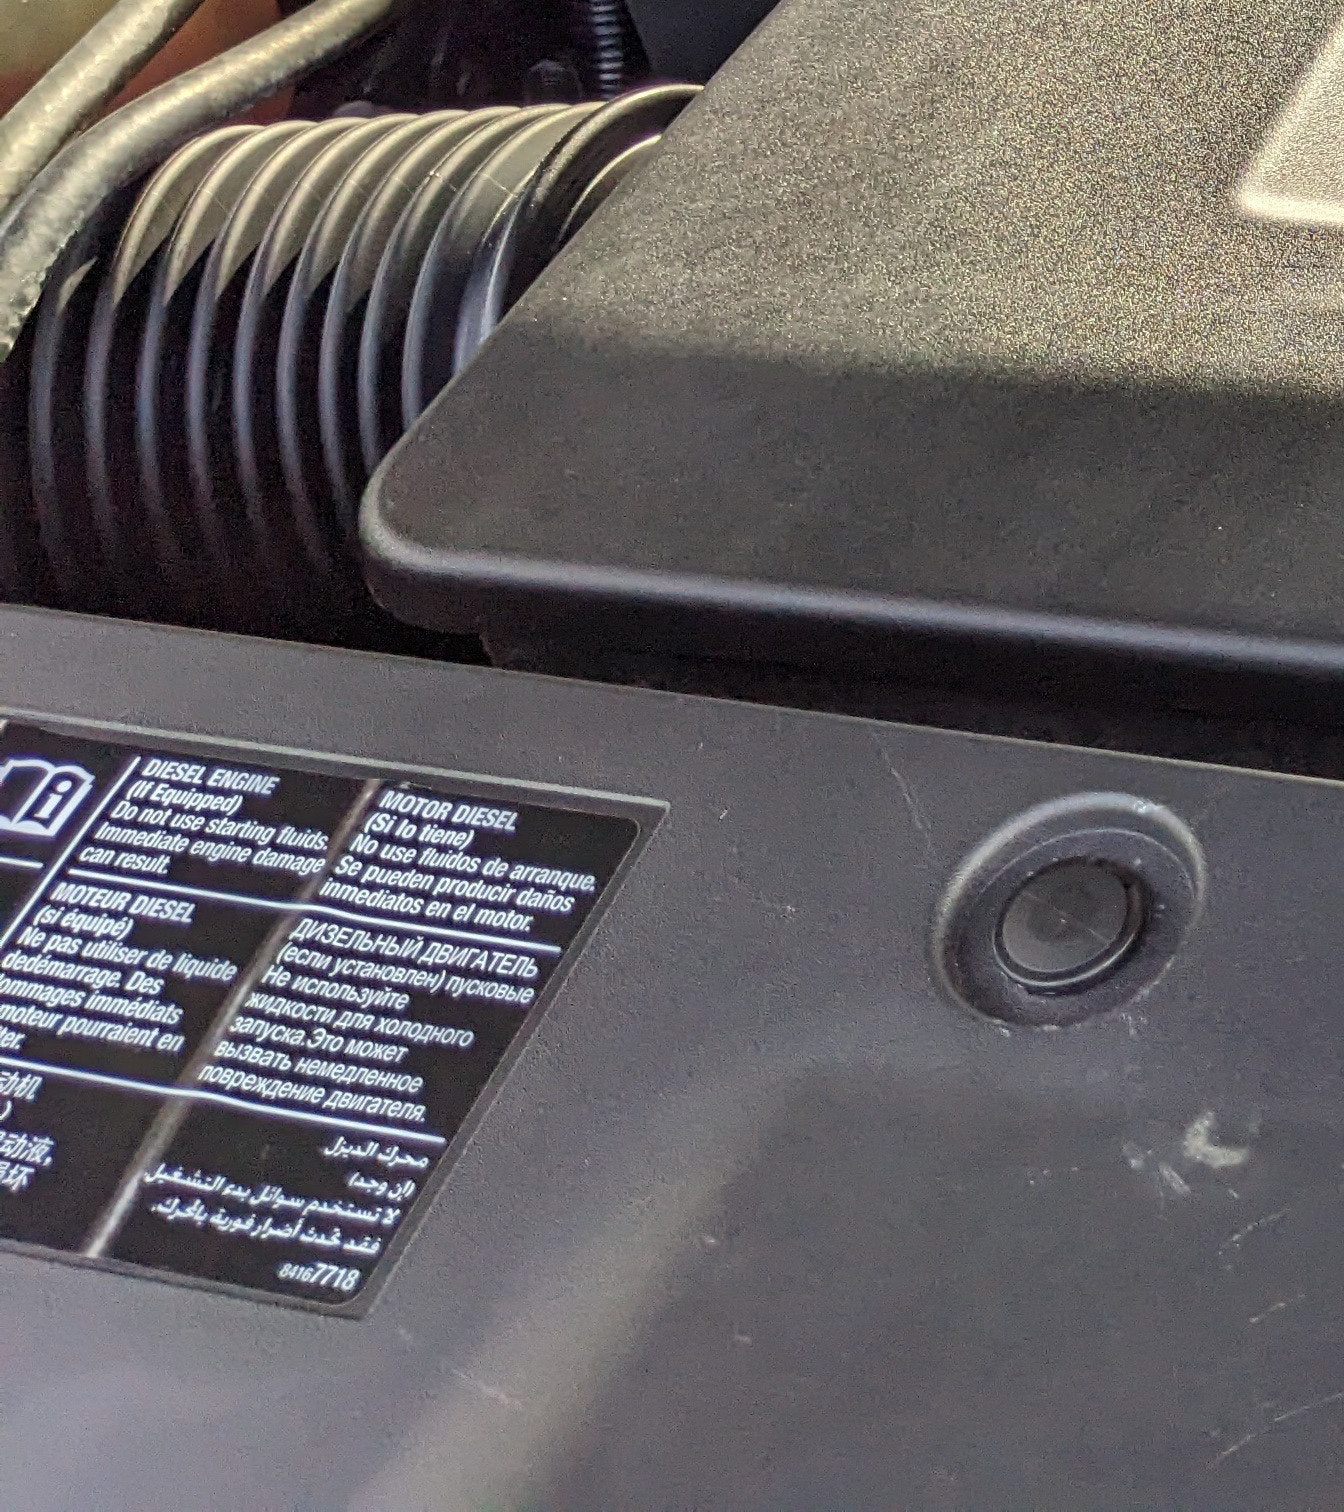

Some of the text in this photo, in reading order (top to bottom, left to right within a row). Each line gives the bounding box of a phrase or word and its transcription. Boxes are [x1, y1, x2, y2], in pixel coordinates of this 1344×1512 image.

[126, 780, 243, 815] (If Equipped)
[142, 759, 280, 794] DIESEL ENGINE
[110, 801, 328, 850] Do not use starting fluids.
[364, 813, 474, 850] (Si lo tiene)
[379, 791, 517, 831] MOTOR DIESEL
[79, 847, 170, 874] can result.
[94, 822, 326, 875] Immediate engine damage
[350, 834, 595, 891] No use fluidos de arranque.
[50, 882, 195, 922] MOTEUR DIESEL
[319, 878, 533, 931] inmediatos en el motor.
[335, 856, 575, 911] Se pueden producir daños
[33, 905, 133, 940] (si équipé)
[17, 926, 237, 981] Ne pas utiliser de liquide
[289, 918, 538, 977] ДИЗЕЛЬНЫЙ ДВИГАТЕЛЬ
[125, 971, 164, 994] Des
[261, 965, 409, 1009] Не используйте
[277, 942, 534, 1003] (если установлен) пусковые
[0, 974, 183, 1024] ommages immédiats
[245, 992, 473, 1046] жидкости для холодного
[57, 1016, 159, 1047] pourraient
[157, 1034, 184, 1051] en
[344, 1039, 408, 1062] может
[213, 1041, 423, 1093] вызвать немедленное
[197, 1065, 425, 1121] повреждение двигателя.
[323, 1136, 430, 1168] محرك الديزل
[143, 1163, 401, 1226] لا تستخدم سوائل بدء التشغيل
[210, 1208, 257, 1233] فورية
[342, 1236, 382, 1255] فقد
[278, 1262, 360, 1291] 84167718
